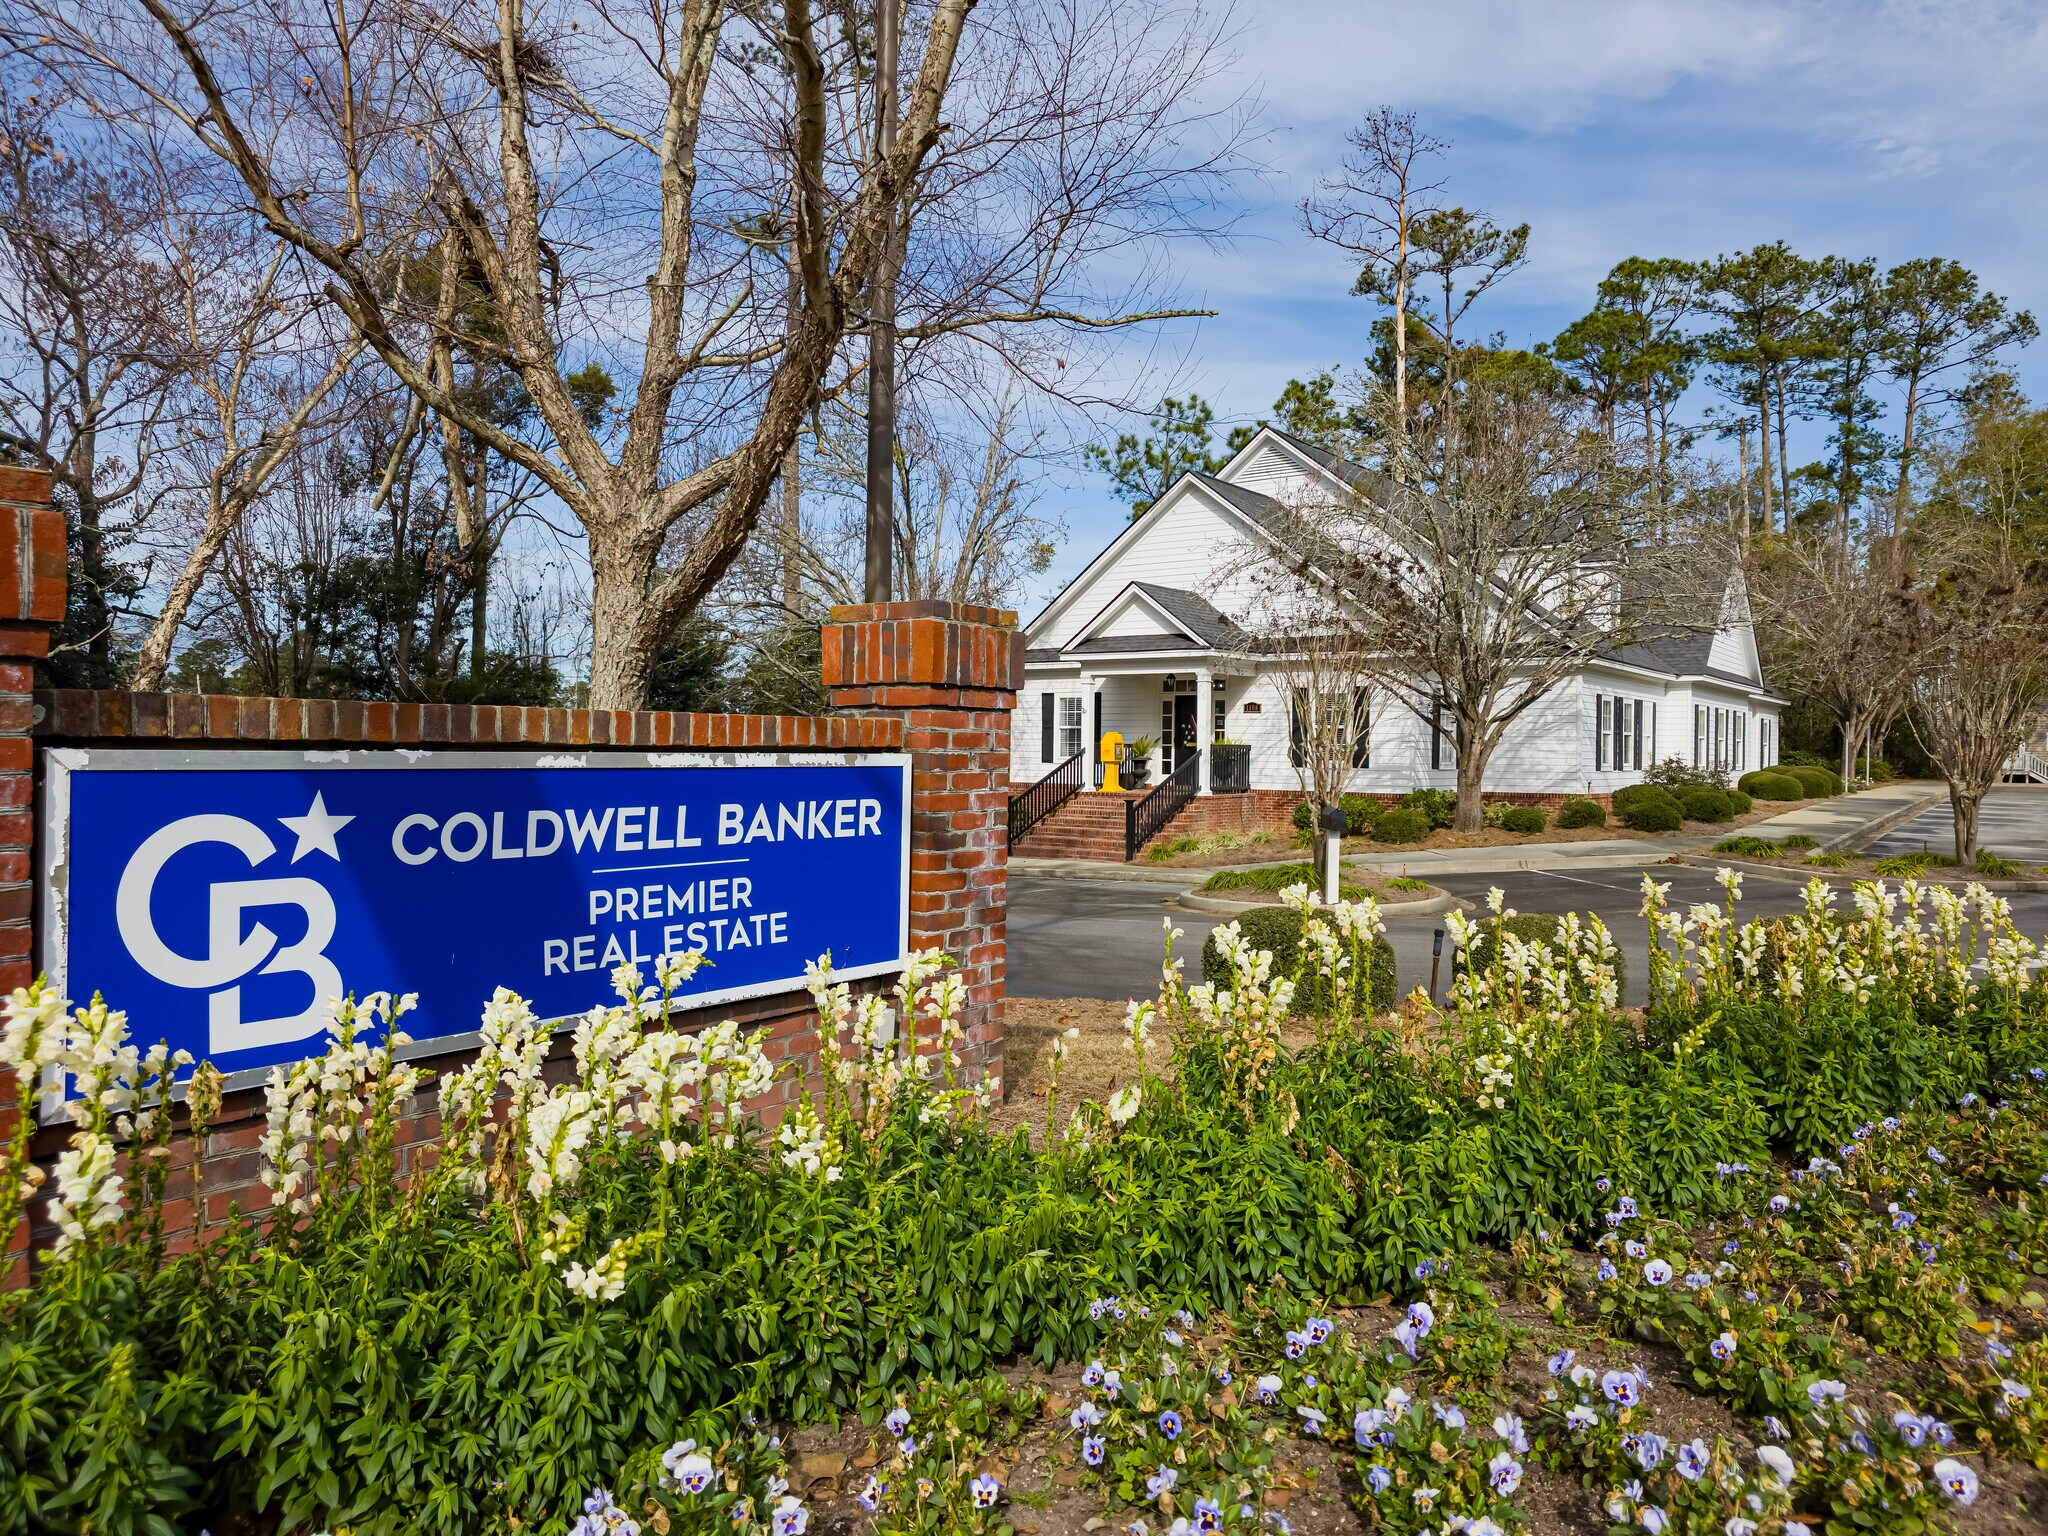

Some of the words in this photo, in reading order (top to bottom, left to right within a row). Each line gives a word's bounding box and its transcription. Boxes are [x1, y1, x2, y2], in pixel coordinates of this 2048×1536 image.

[391, 804, 702, 866] COLDWELL
[717, 798, 882, 846] BANKER
[589, 877, 753, 926] PREMIER
[543, 929, 652, 977] REAL
[663, 911, 789, 960] ESTATE
